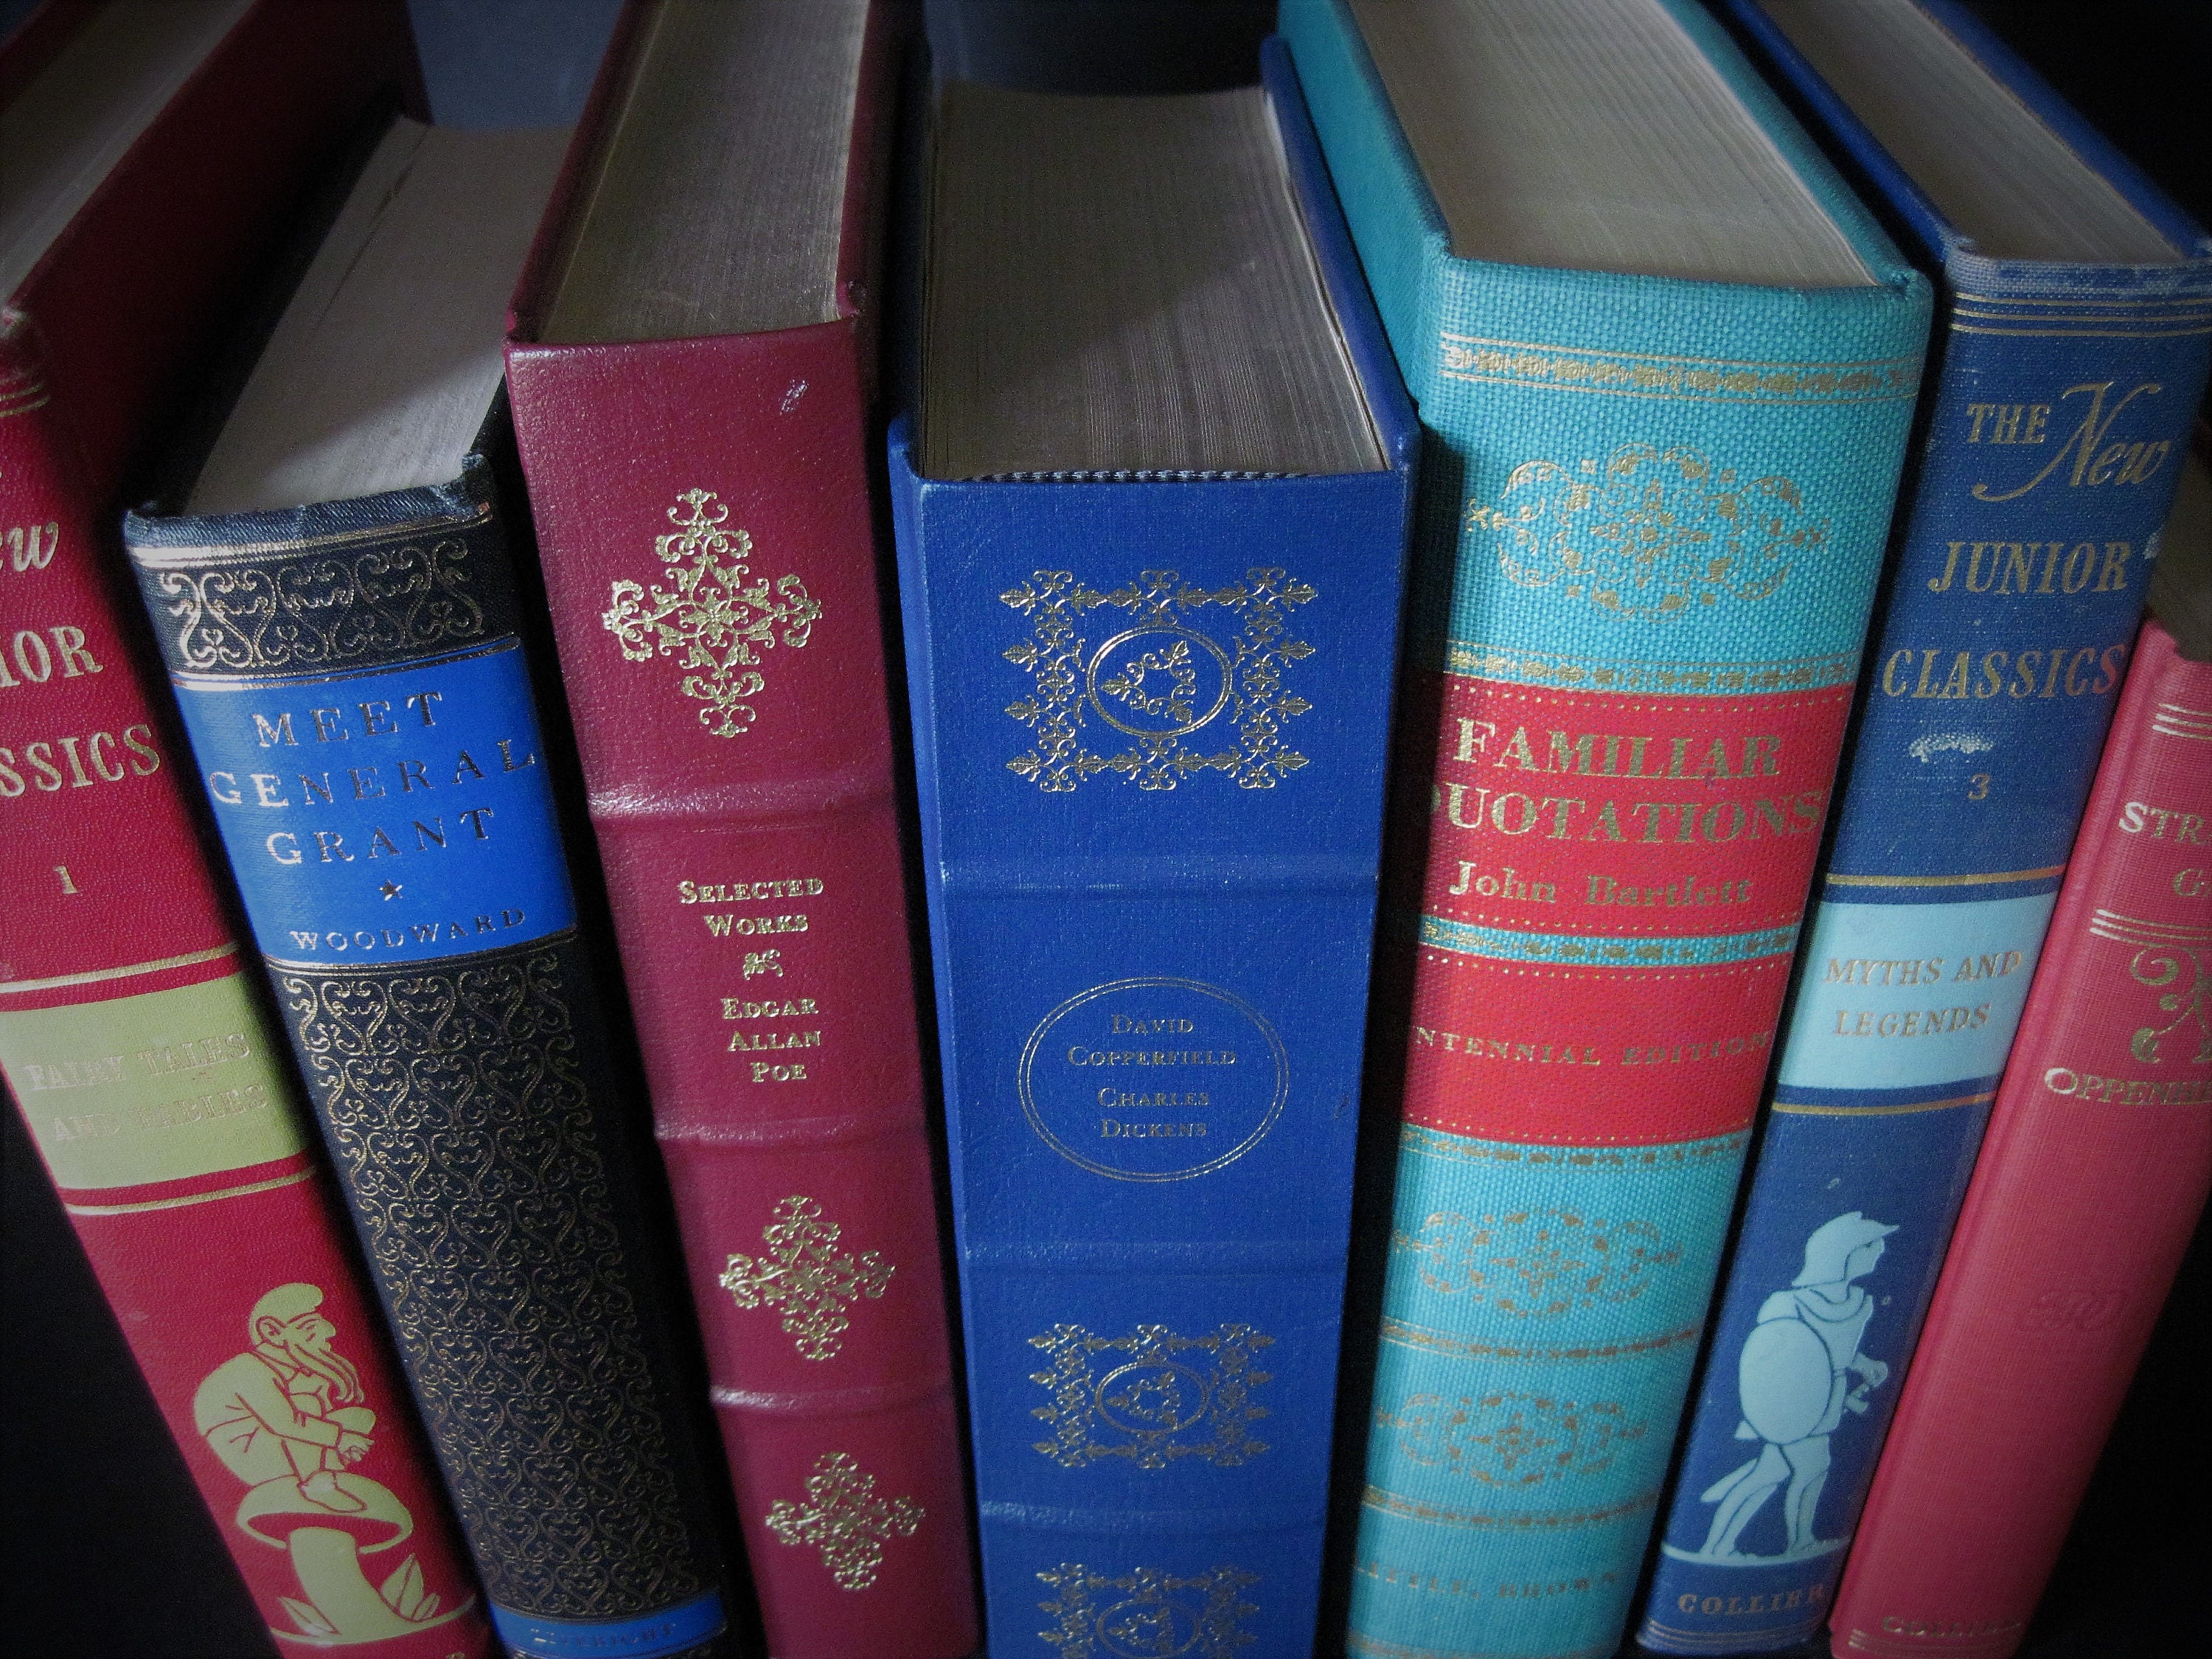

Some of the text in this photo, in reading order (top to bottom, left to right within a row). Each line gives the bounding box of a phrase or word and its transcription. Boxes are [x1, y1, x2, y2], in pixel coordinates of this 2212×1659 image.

[1966, 381, 2171, 501] THE New
[1928, 541, 2130, 594] JUNIOR
[1882, 643, 2127, 700] CLASSICS
[251, 692, 442, 747] MEET
[1453, 717, 1782, 780] FAMILIAR
[209, 739, 535, 807] GENERAL
[1968, 773, 1990, 800] 3
[1430, 782, 1825, 843] UOTATIONS
[2118, 801, 2212, 845] STR
[267, 807, 493, 865] GRANT
[53, 866, 78, 894] 1
[678, 878, 824, 904] SELECTED
[1449, 860, 1753, 906] John Bartlett
[291, 908, 526, 951] WOODWARD
[704, 914, 808, 936] WORKS
[1825, 950, 2023, 985] MYTHS AND
[720, 998, 818, 1020] EDGAR
[1111, 1015, 1194, 1034] DAVID
[1833, 1004, 1991, 1037] LEGENDS
[136, 1033, 251, 1077] TALES
[727, 1031, 821, 1051] ALLAN
[1068, 1046, 1237, 1065] COPPERFIELD
[1621, 1031, 1770, 1065] EDITION
[751, 1062, 807, 1082] POE
[1097, 1088, 1210, 1107] CHARLES
[1102, 1119, 1208, 1138] DICKENS
